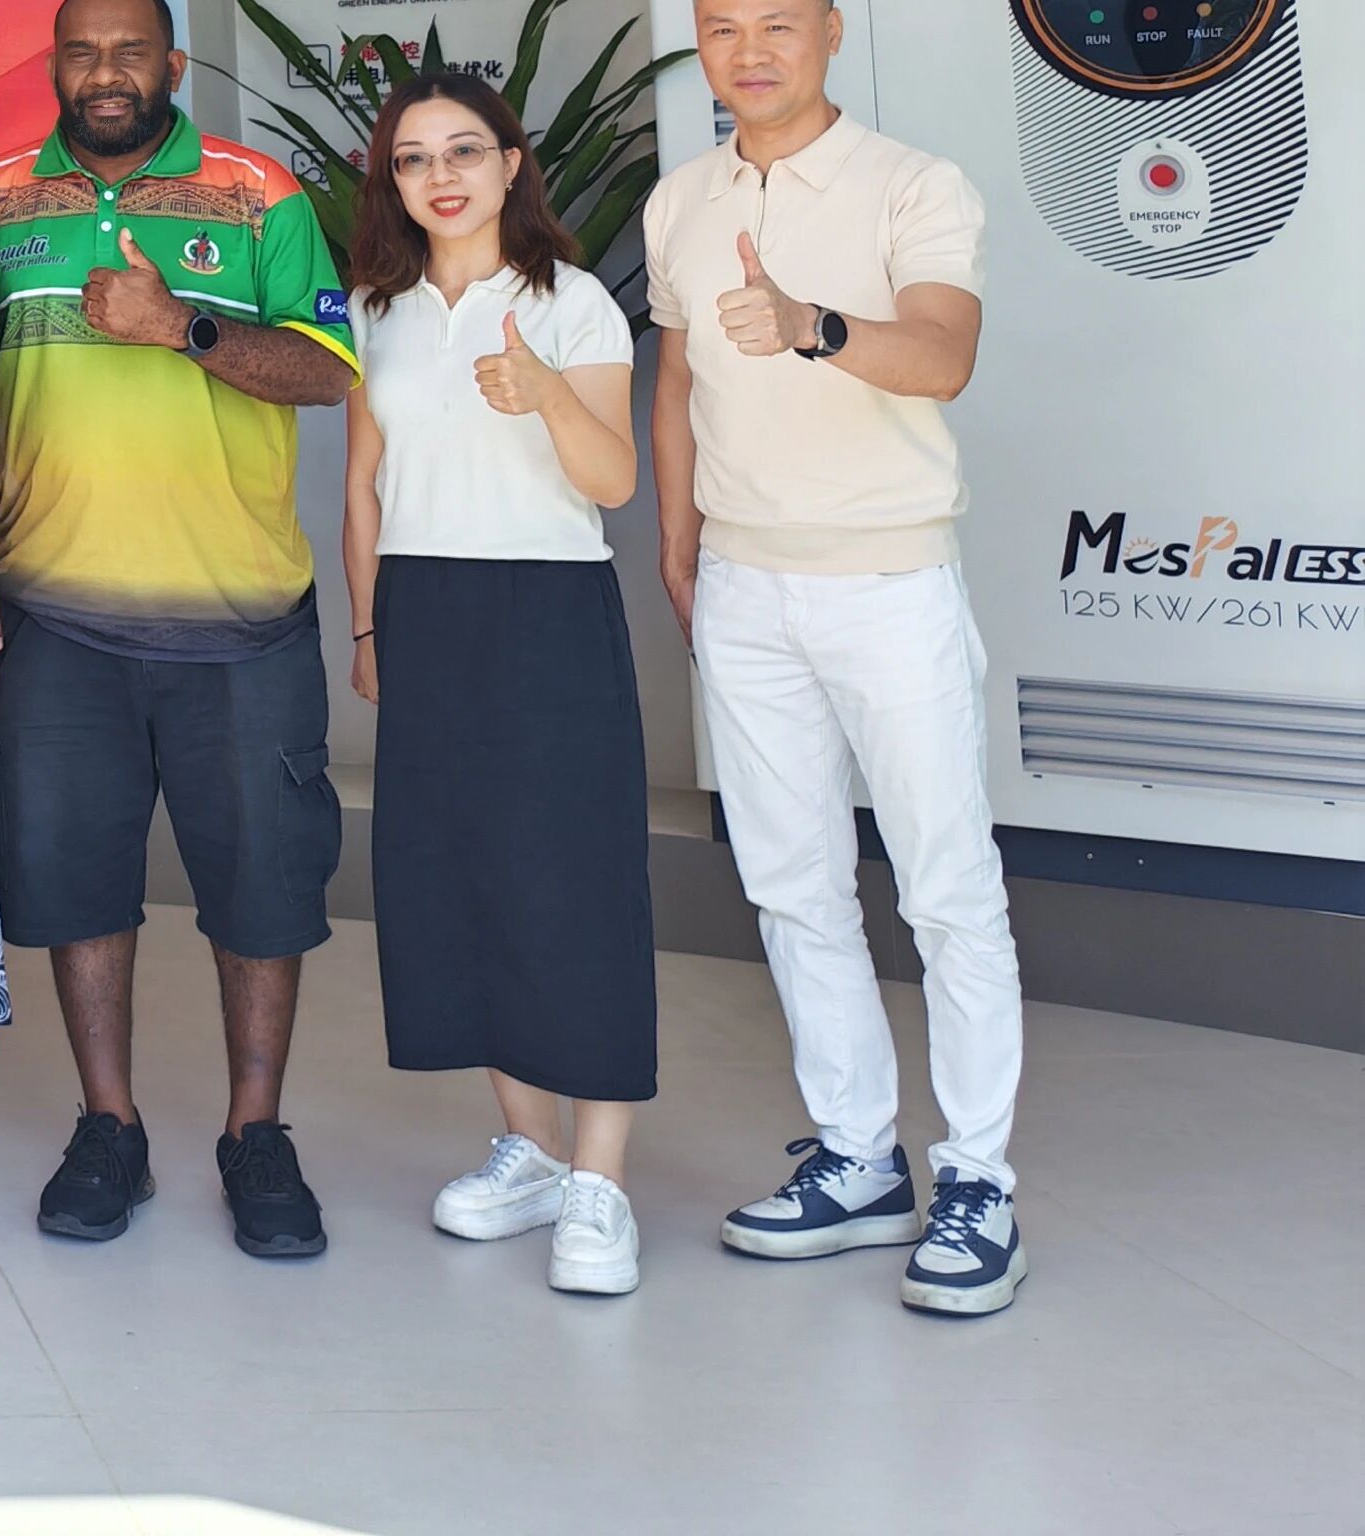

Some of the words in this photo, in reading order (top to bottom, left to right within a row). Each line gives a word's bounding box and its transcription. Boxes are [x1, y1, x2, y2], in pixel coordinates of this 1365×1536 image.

[338, 0, 369, 8] GREEN
[1085, 35, 1111, 45] RUN
[1137, 31, 1167, 42] STOP
[1187, 27, 1223, 39] FAULT
[1129, 211, 1200, 221] EMERGENCY
[1152, 224, 1181, 233] STOP
[1060, 510, 1282, 582] MesPal
[1292, 548, 1365, 579] ESS
[1060, 589, 1120, 617] 125
[1134, 593, 1282, 628] KW/261
[1298, 602, 1365, 632] KW
